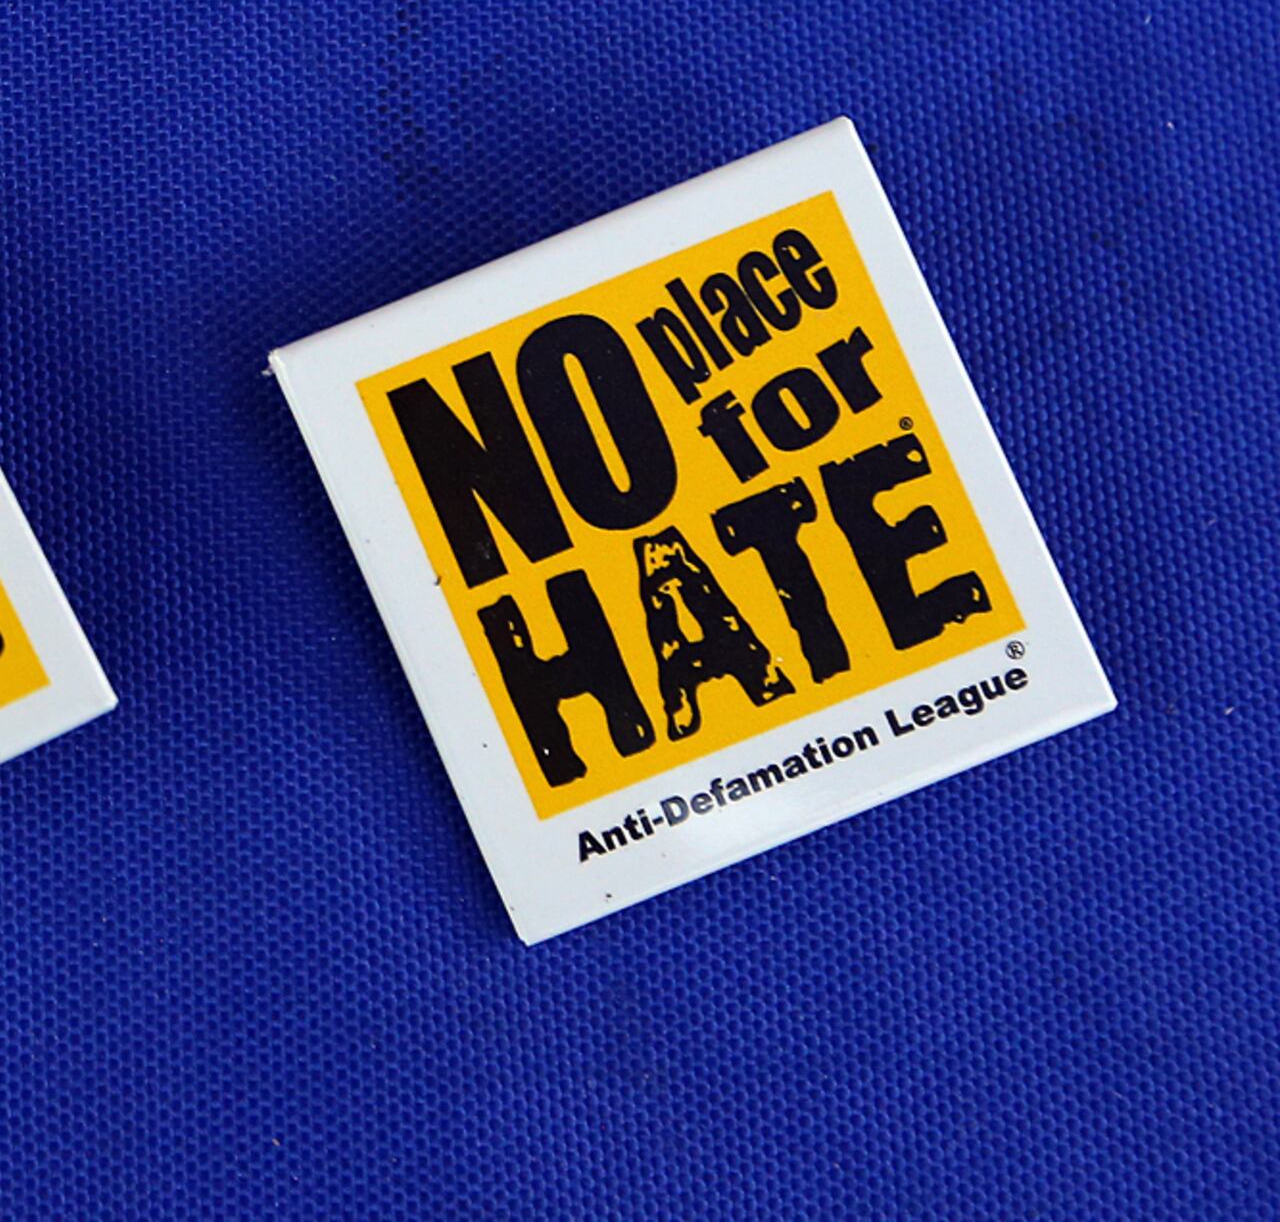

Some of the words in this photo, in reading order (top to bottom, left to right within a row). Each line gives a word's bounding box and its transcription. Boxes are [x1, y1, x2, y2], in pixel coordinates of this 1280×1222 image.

[387, 313, 679, 589] NO
[635, 228, 839, 405] place
[698, 326, 873, 484] for
[576, 723, 879, 863] Anti-Defamation
